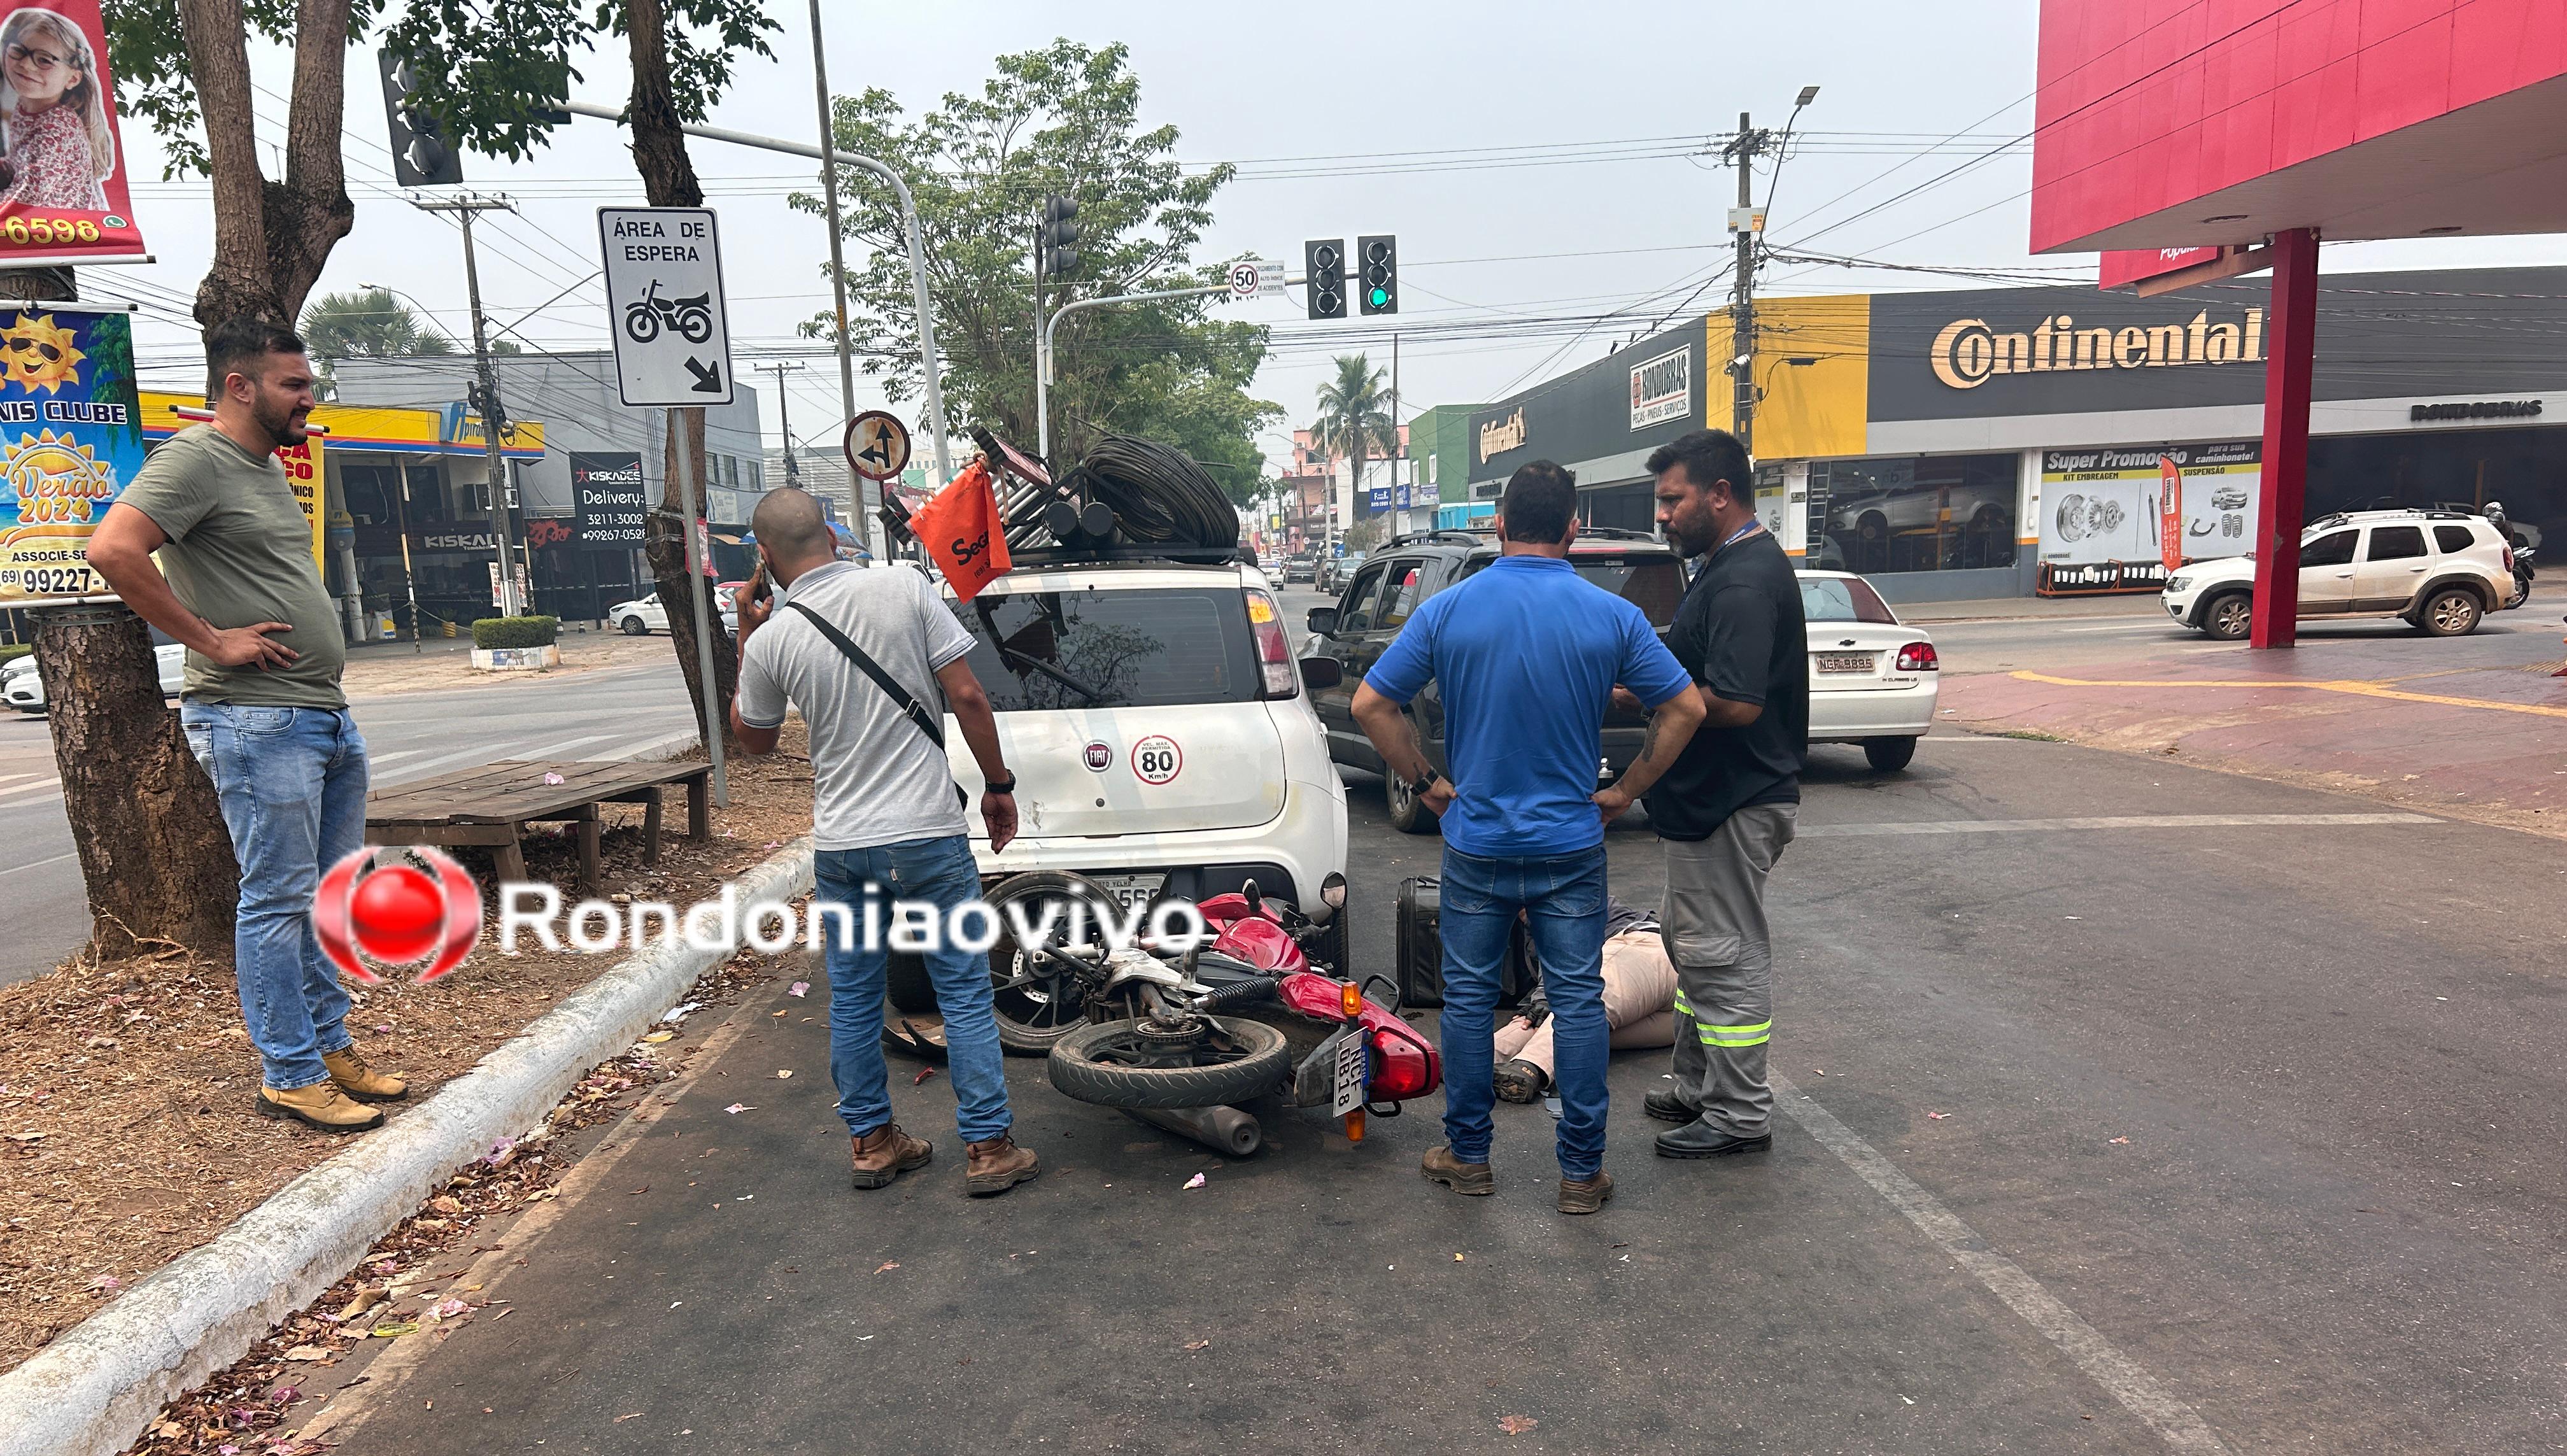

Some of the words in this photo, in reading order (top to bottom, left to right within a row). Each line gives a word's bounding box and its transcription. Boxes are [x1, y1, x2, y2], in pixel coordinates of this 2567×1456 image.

[613, 217, 665, 237] ÁREA
[681, 223, 705, 237] DE
[625, 246, 700, 262] ESPERA
[1235, 271, 1254, 287] 50
[1930, 308, 2264, 390] Continental
[1642, 354, 1687, 402] RONDOBRAS
[45, 401, 127, 424] CLUBE
[2047, 453, 2098, 472] Super
[2208, 445, 2228, 455] para
[2195, 451, 2254, 463] caminhonete!
[10, 467, 112, 498] Verão
[2077, 472, 2119, 481] EMBREAGEM
[2184, 465, 2225, 476] SUSPENSÃO
[583, 490, 644, 507] Delivery:
[17, 498, 91, 523] 2024
[587, 513, 644, 525] 3211-3002
[12, 550, 88, 562] ASSOCIE-SE
[24, 568, 111, 593] 99227-
[1089, 749, 1107, 763] FIAT
[1142, 751, 1173, 772] 80
[1350, 1048, 1362, 1091] NCF
